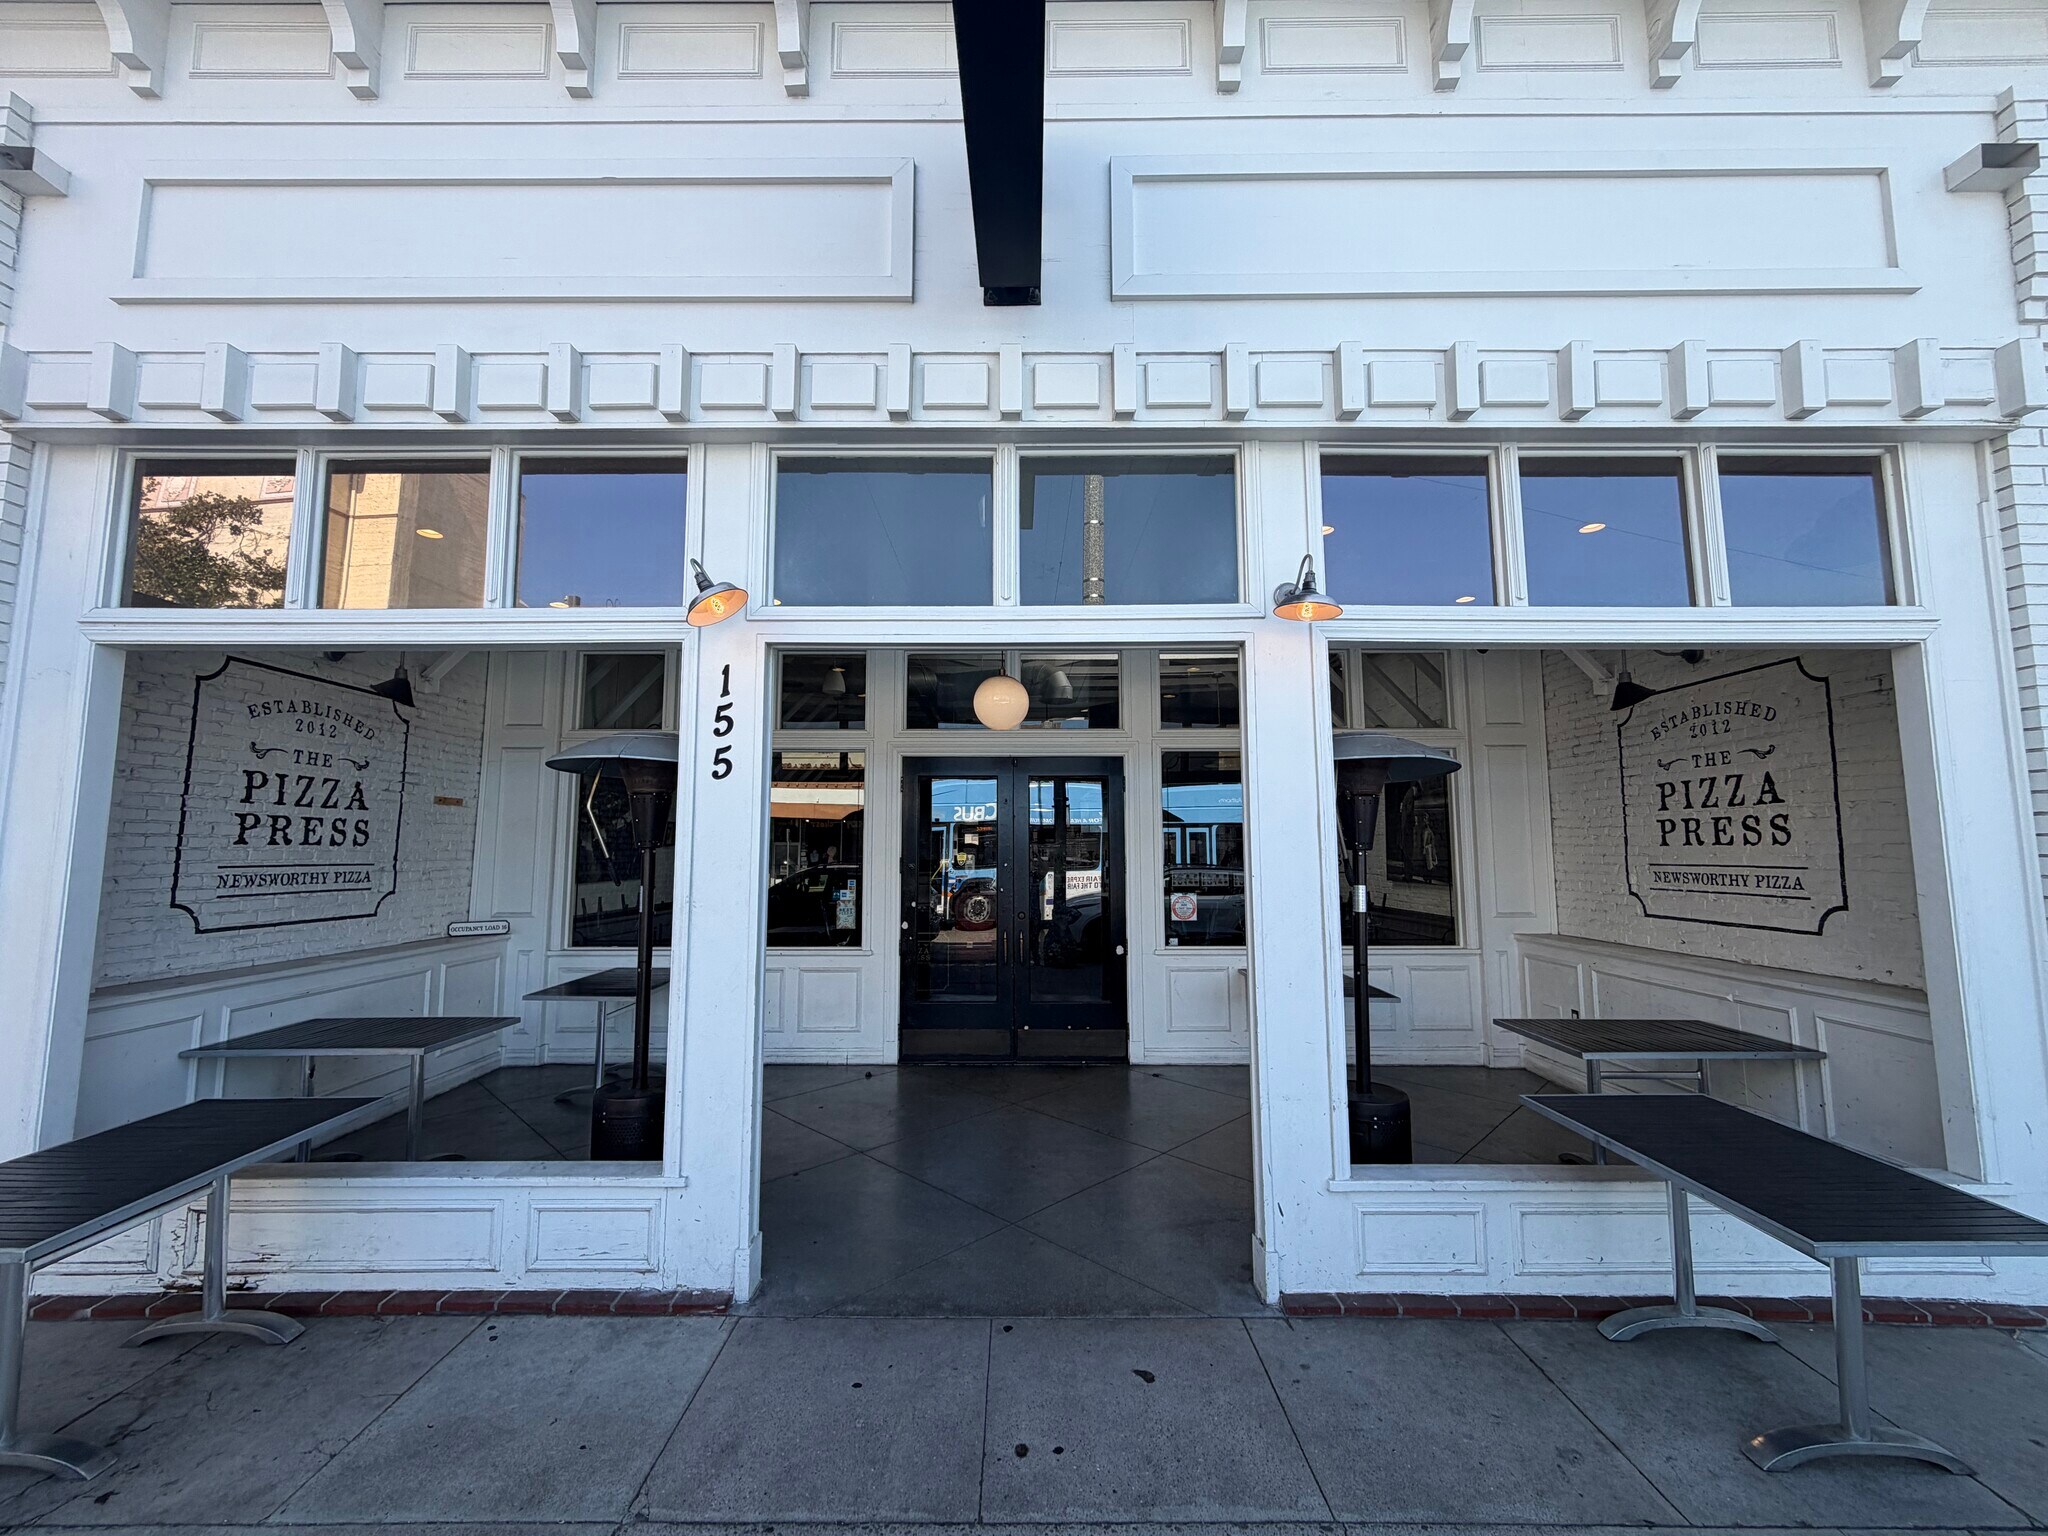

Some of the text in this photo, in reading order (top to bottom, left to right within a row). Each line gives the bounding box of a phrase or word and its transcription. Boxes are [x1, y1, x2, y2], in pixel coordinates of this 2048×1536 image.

[247, 699, 375, 740] ESTABLISHED
[296, 719, 337, 738] 2012
[712, 664, 734, 780] 155
[1651, 701, 1777, 740] ESTABLISHED
[1690, 720, 1731, 738] 2012
[293, 749, 333, 767] THE
[1692, 751, 1732, 768] THE
[240, 769, 369, 810] PIZZA
[1656, 771, 1785, 812] PIZZA
[233, 812, 370, 847] PRESS
[1656, 814, 1792, 846] PRESS
[217, 871, 371, 889] NEWSWORTHY PIZZA
[1653, 871, 1804, 890] NEWSWORTHY PIZZA
[451, 925, 483, 933] OCCUPANCY
